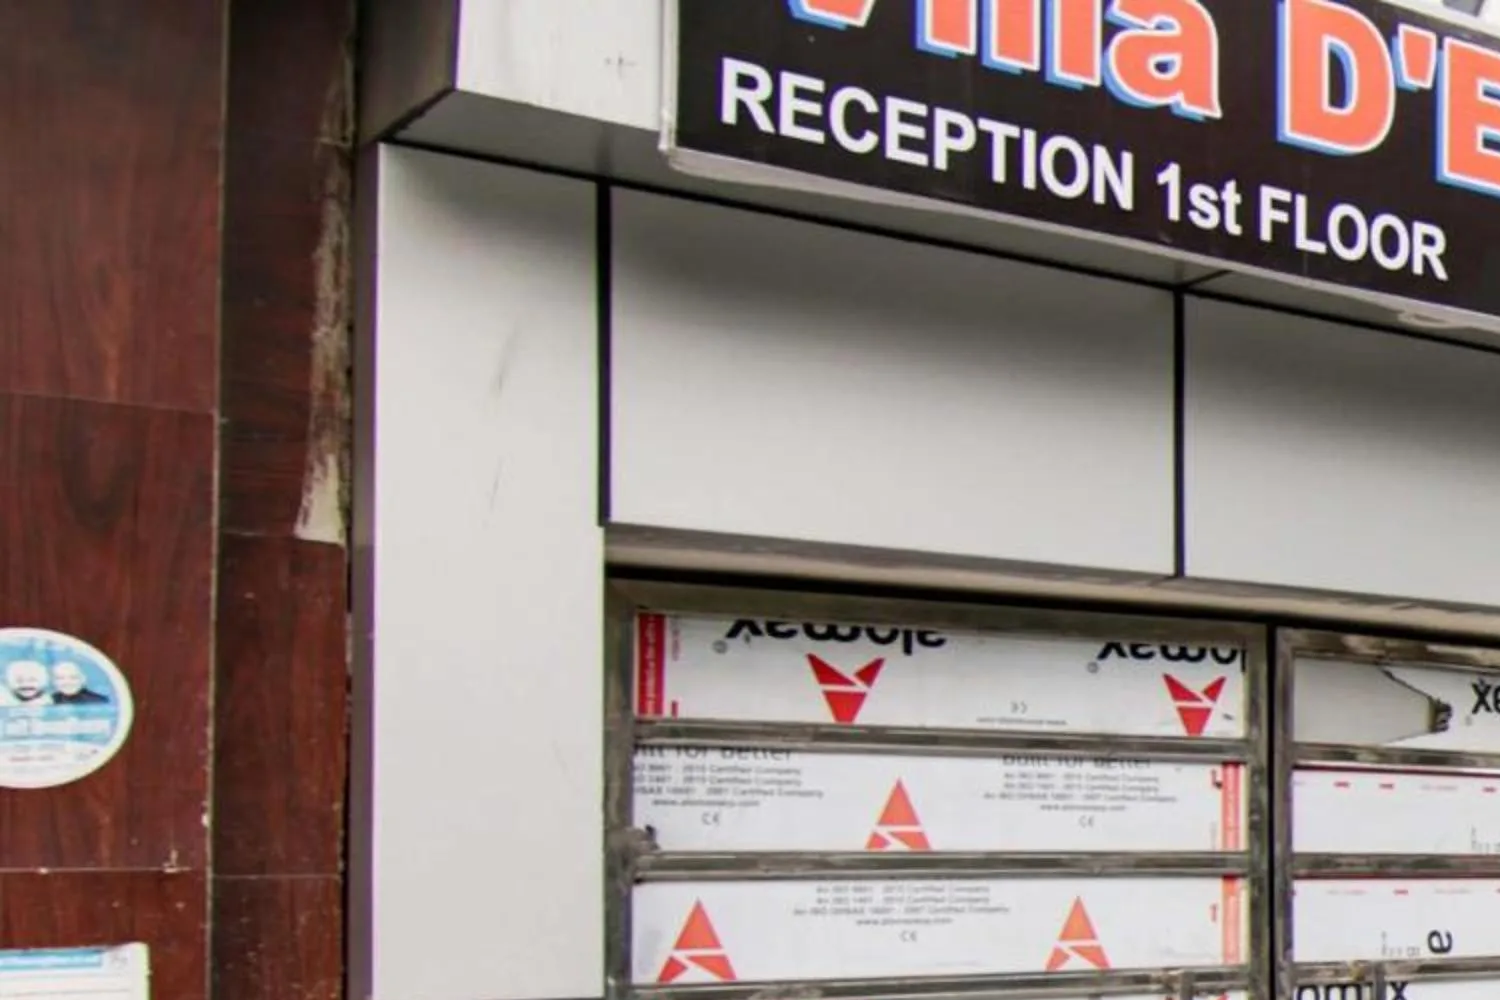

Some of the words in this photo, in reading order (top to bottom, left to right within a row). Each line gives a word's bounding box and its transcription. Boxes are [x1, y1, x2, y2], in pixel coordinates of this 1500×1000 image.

[720, 58, 1134, 211] RECEPTION
[1156, 161, 1244, 236] 1st
[1259, 184, 1449, 282] FLOOR
